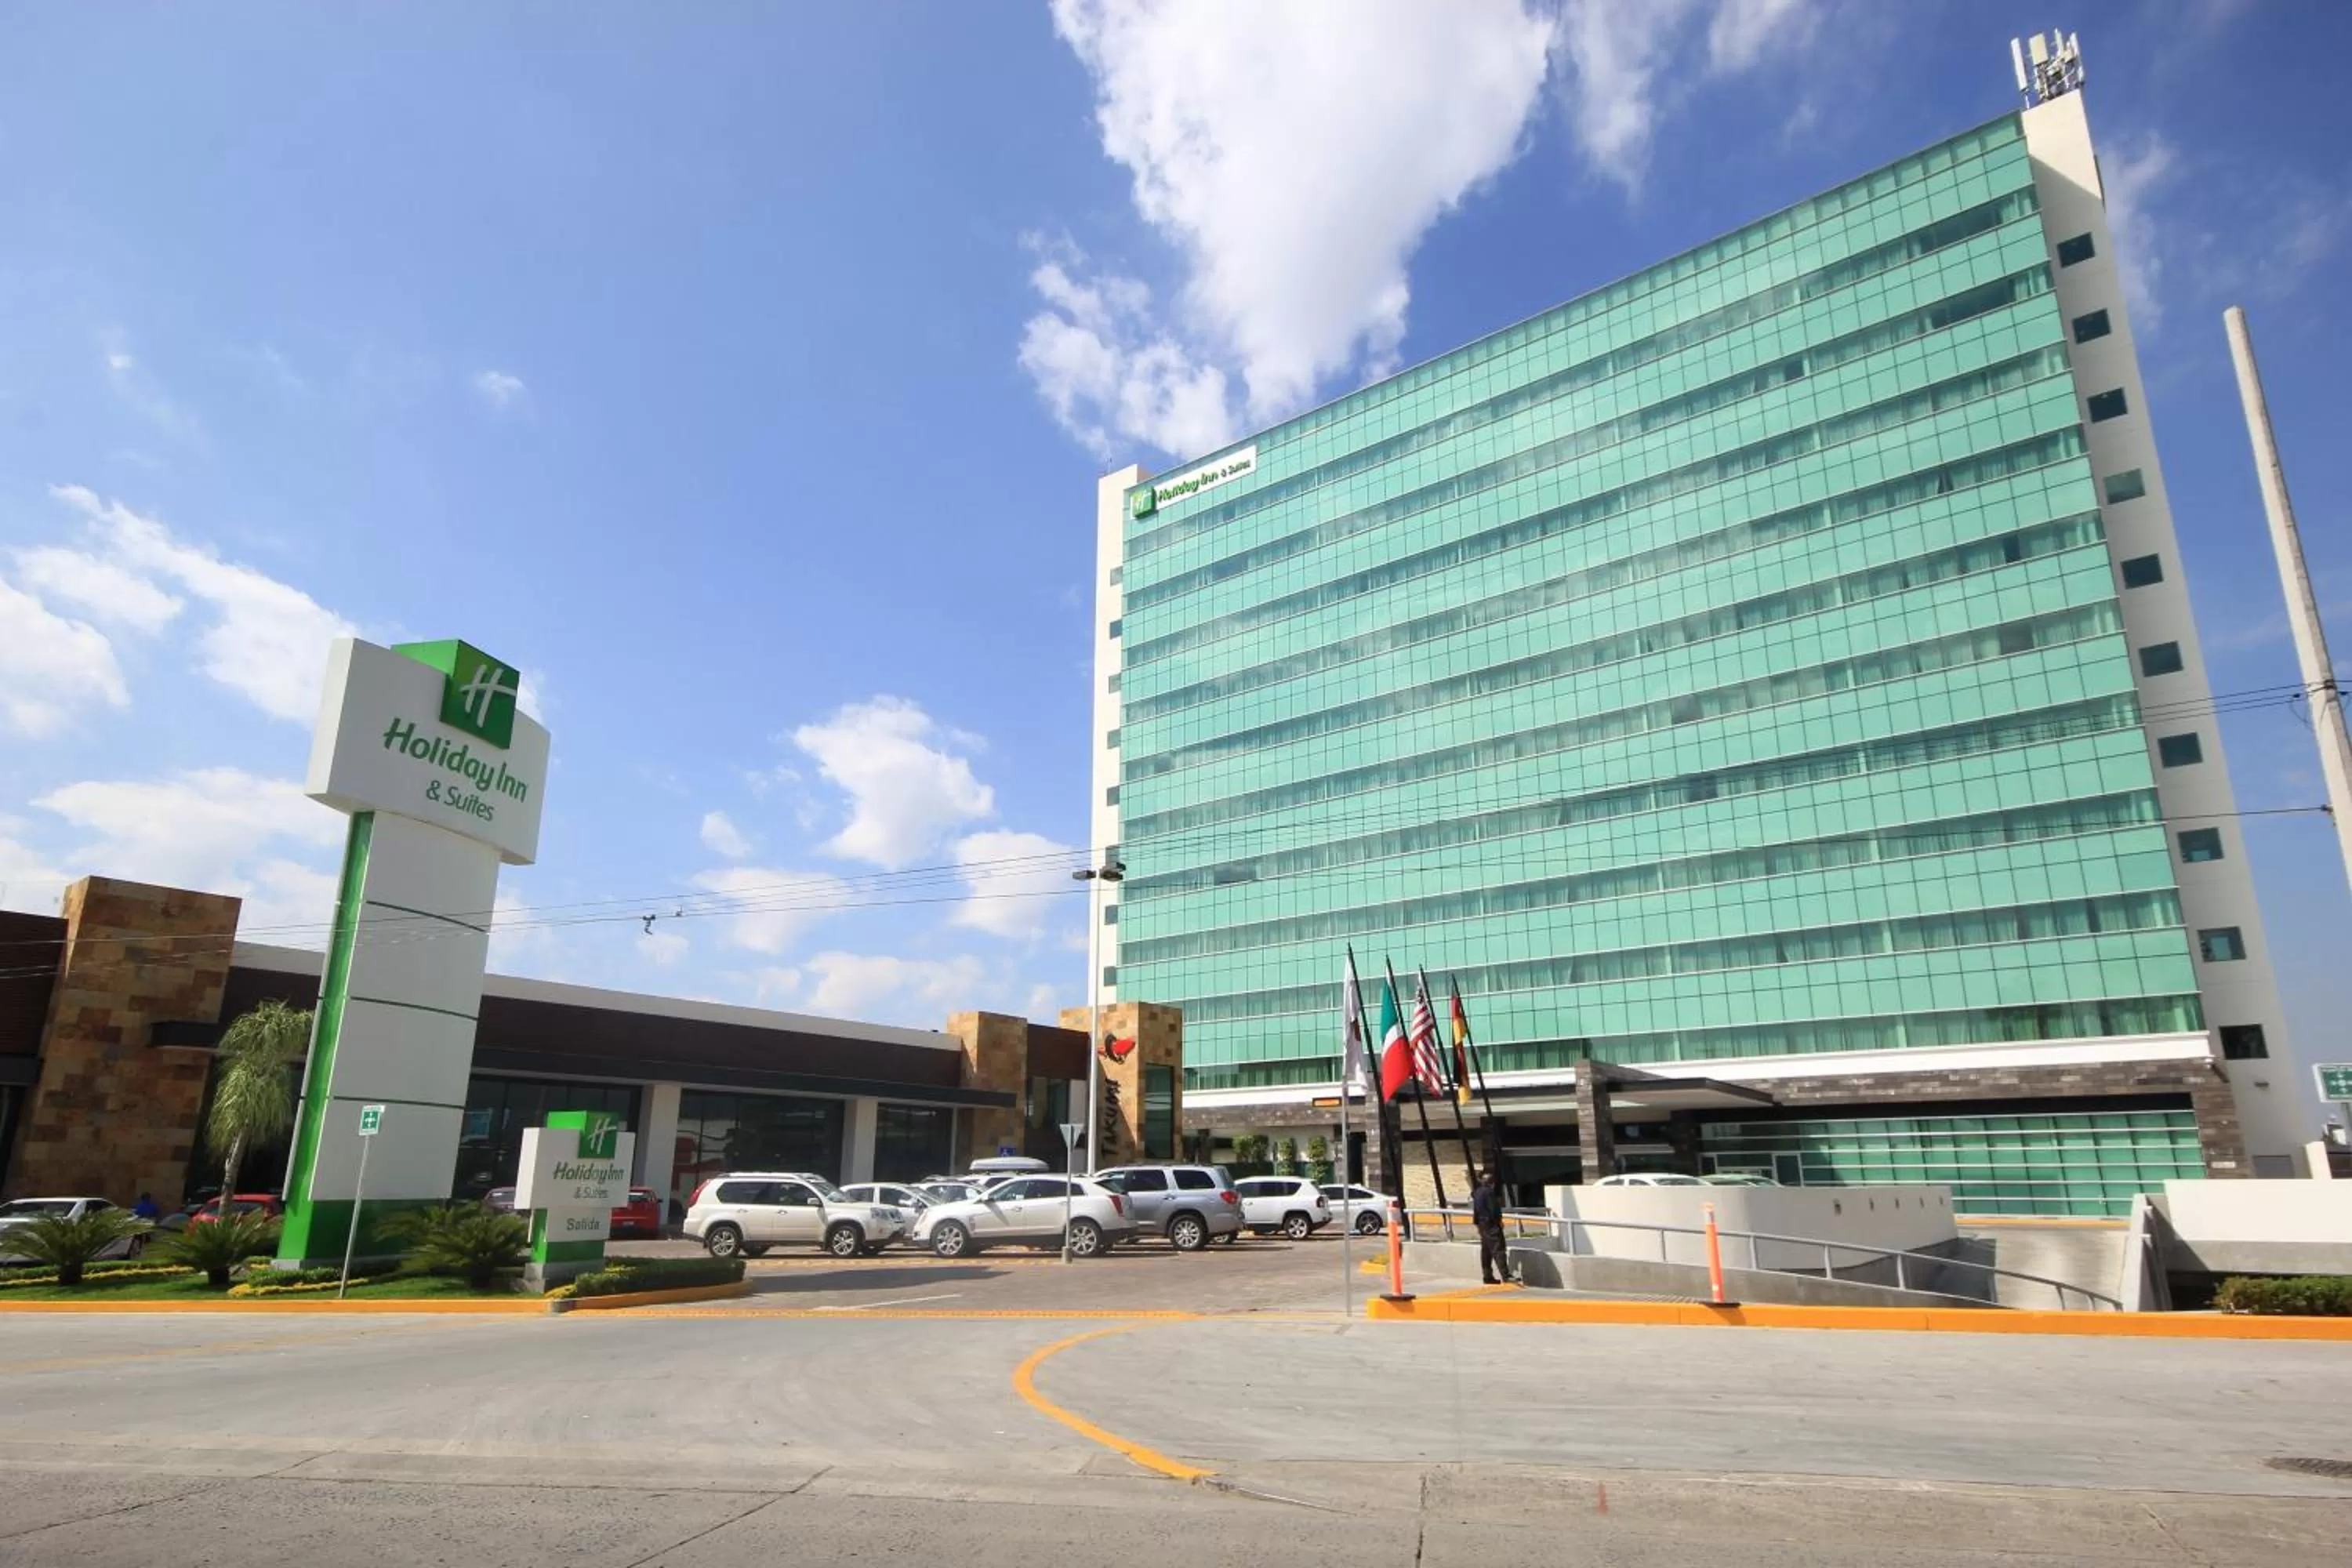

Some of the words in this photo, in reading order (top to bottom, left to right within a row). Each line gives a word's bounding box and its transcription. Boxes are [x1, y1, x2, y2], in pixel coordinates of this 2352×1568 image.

[1158, 479, 1199, 502] Holiday
[1200, 472, 1218, 485] Inn
[383, 717, 495, 792] Holiday
[495, 761, 529, 803] Inn
[426, 780, 441, 802] &
[444, 786, 495, 822] Suites
[1101, 1078, 1120, 1158] TAKUMI
[583, 1186, 608, 1199] Suites
[566, 1218, 601, 1230] Salida
